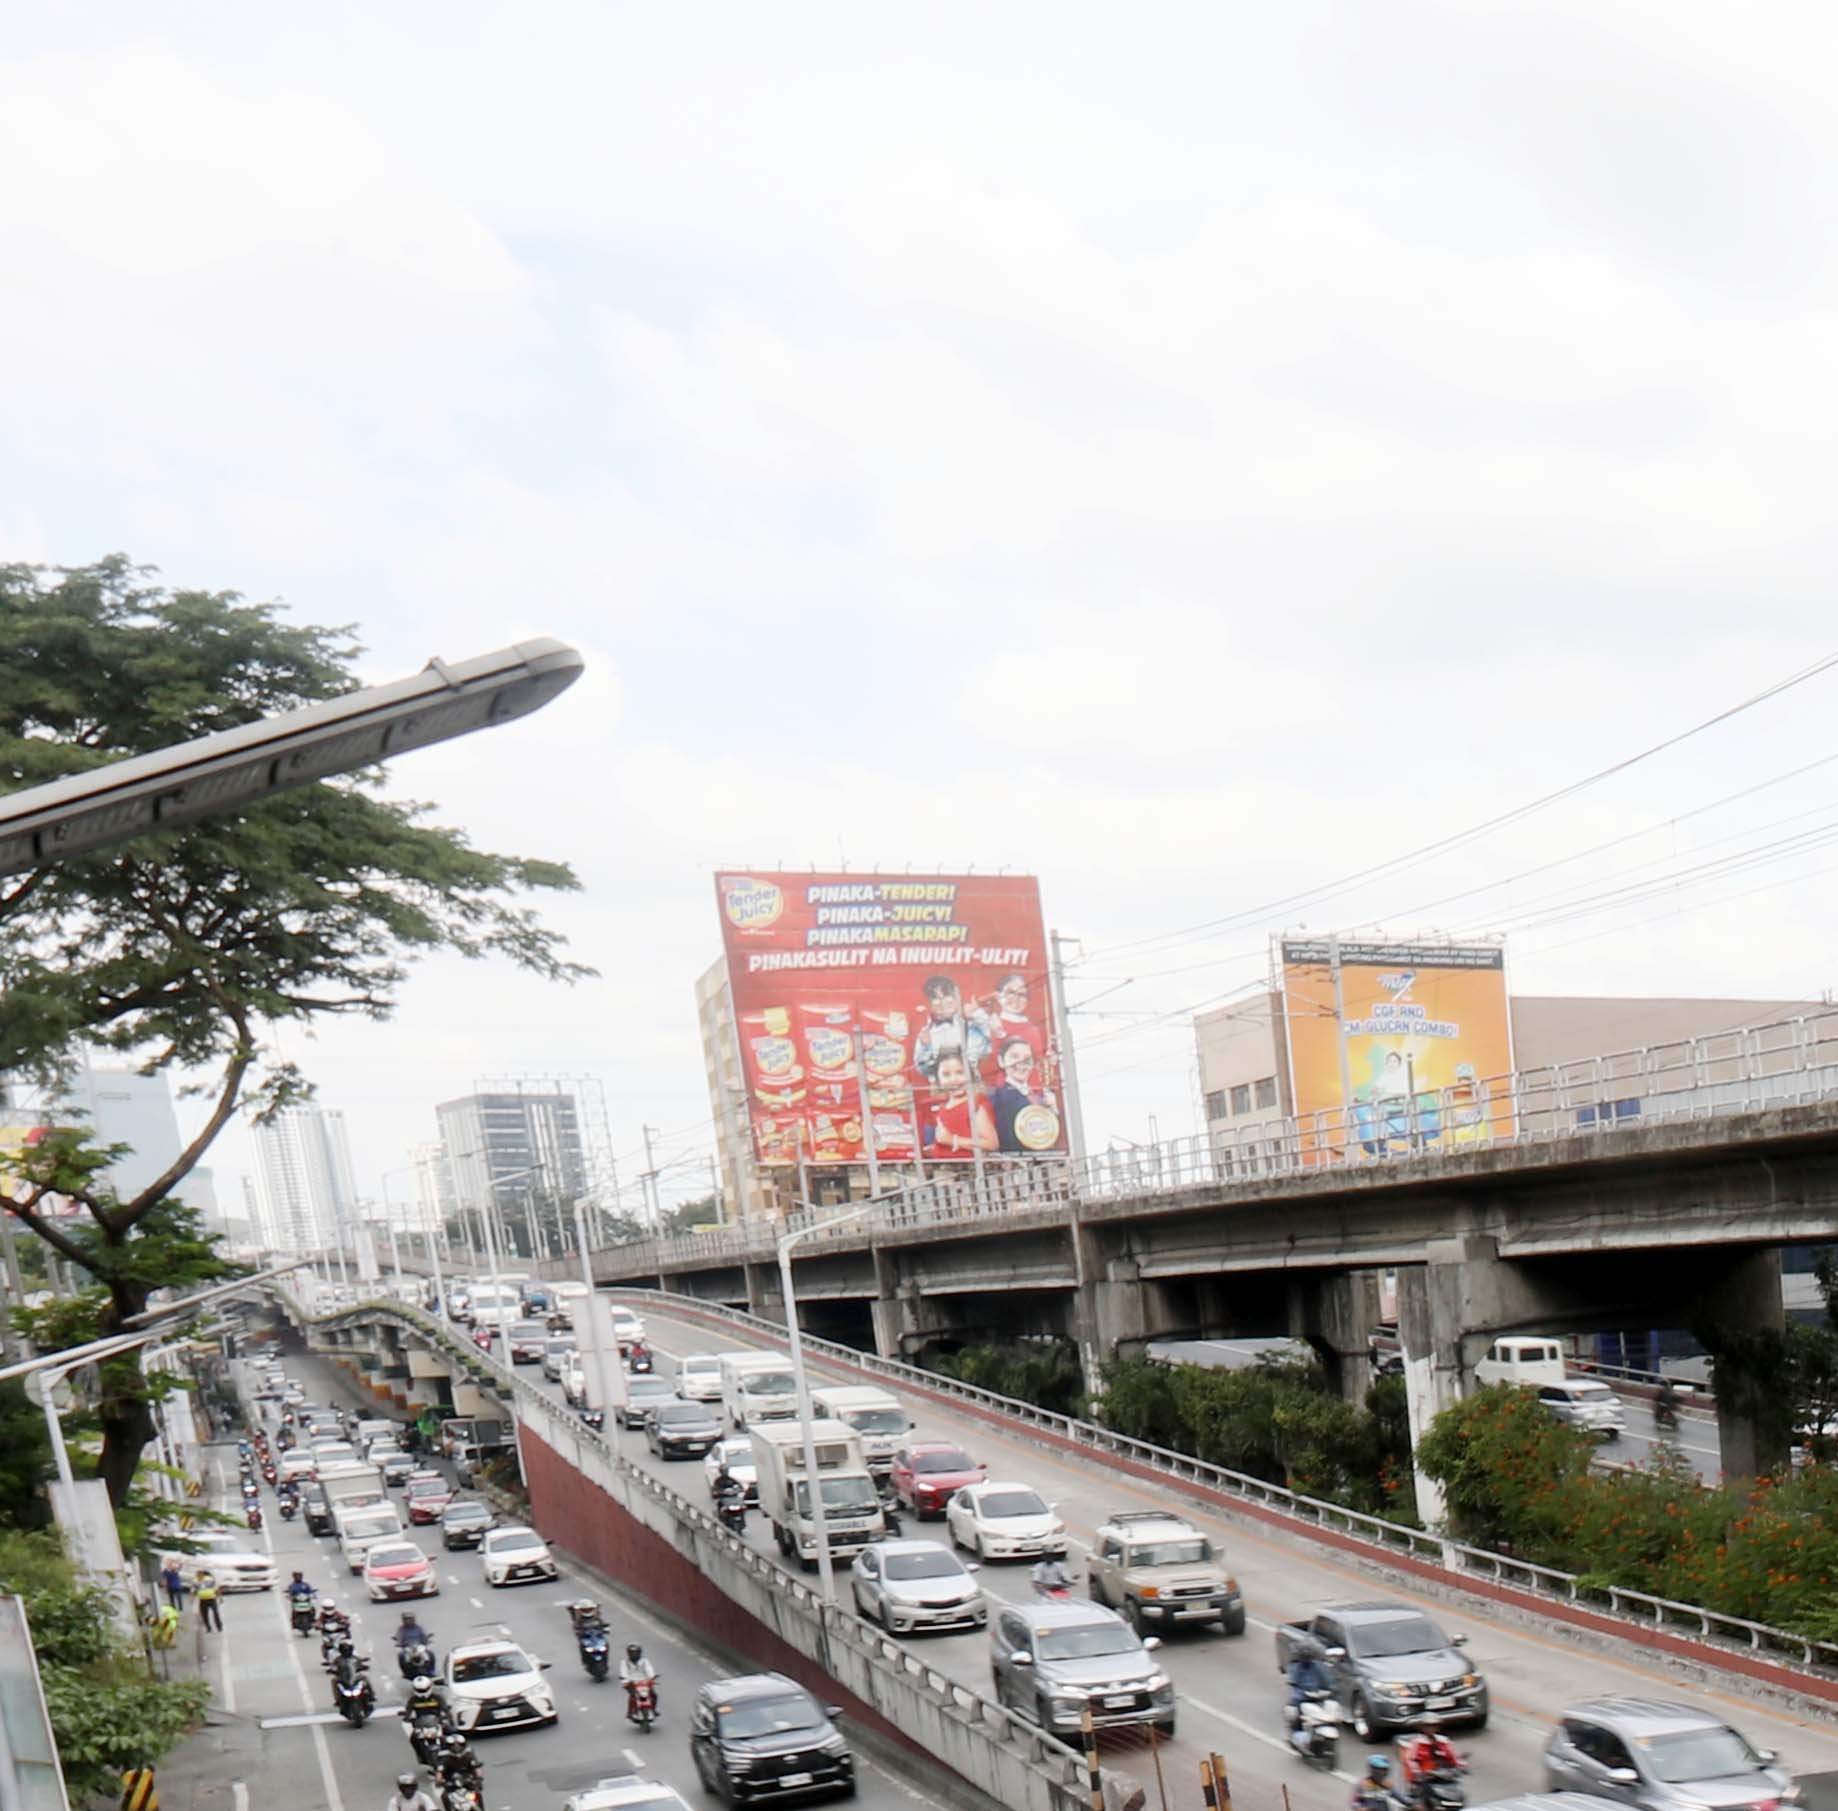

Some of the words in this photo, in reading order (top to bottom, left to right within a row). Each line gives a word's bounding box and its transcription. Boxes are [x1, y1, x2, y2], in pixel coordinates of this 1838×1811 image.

[807, 884, 956, 903] PINAKA-TENDER!
[816, 905, 953, 924] PINAKA-JUICY!
[749, 948, 868, 972] PINAKASULIT
[872, 948, 896, 964] NA
[900, 948, 1029, 966] INUULIT-ULIT!
[1399, 1006, 1424, 1018] AND
